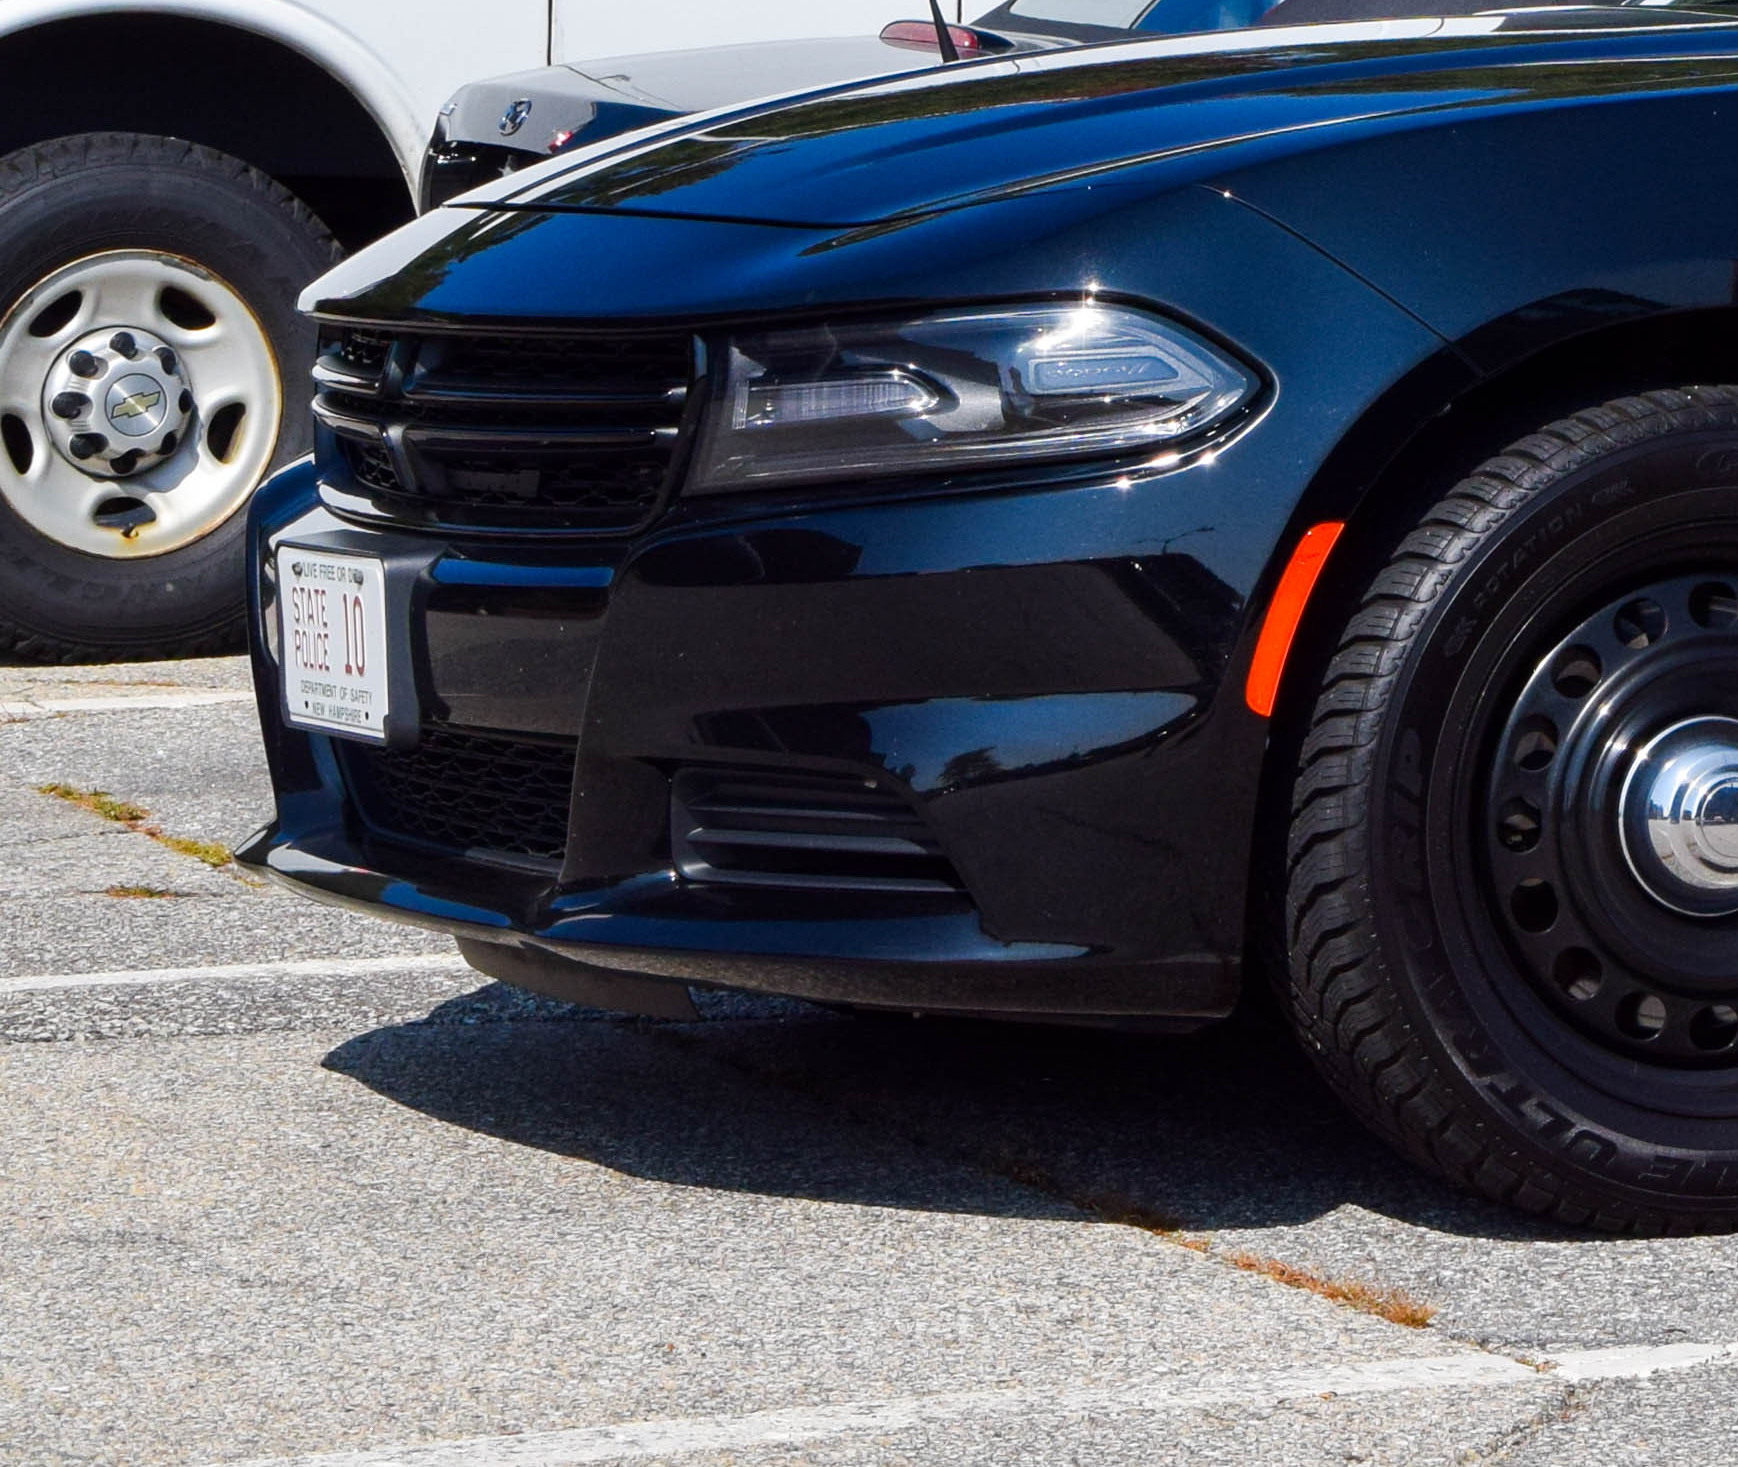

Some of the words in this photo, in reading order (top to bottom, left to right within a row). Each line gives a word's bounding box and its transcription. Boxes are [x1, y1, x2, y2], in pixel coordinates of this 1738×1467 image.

[302, 561, 319, 579] LIVE
[319, 563, 336, 581] FREE
[336, 565, 347, 583] OR
[292, 586, 329, 629] STATE
[294, 628, 331, 673] POLICE
[343, 593, 366, 678] 10
[300, 679, 338, 698] DEPARTMENT
[339, 685, 348, 701] OF
[350, 687, 373, 705] SAFETY
[312, 701, 325, 716] NEW
[328, 703, 363, 724] HAMPSHIRE
